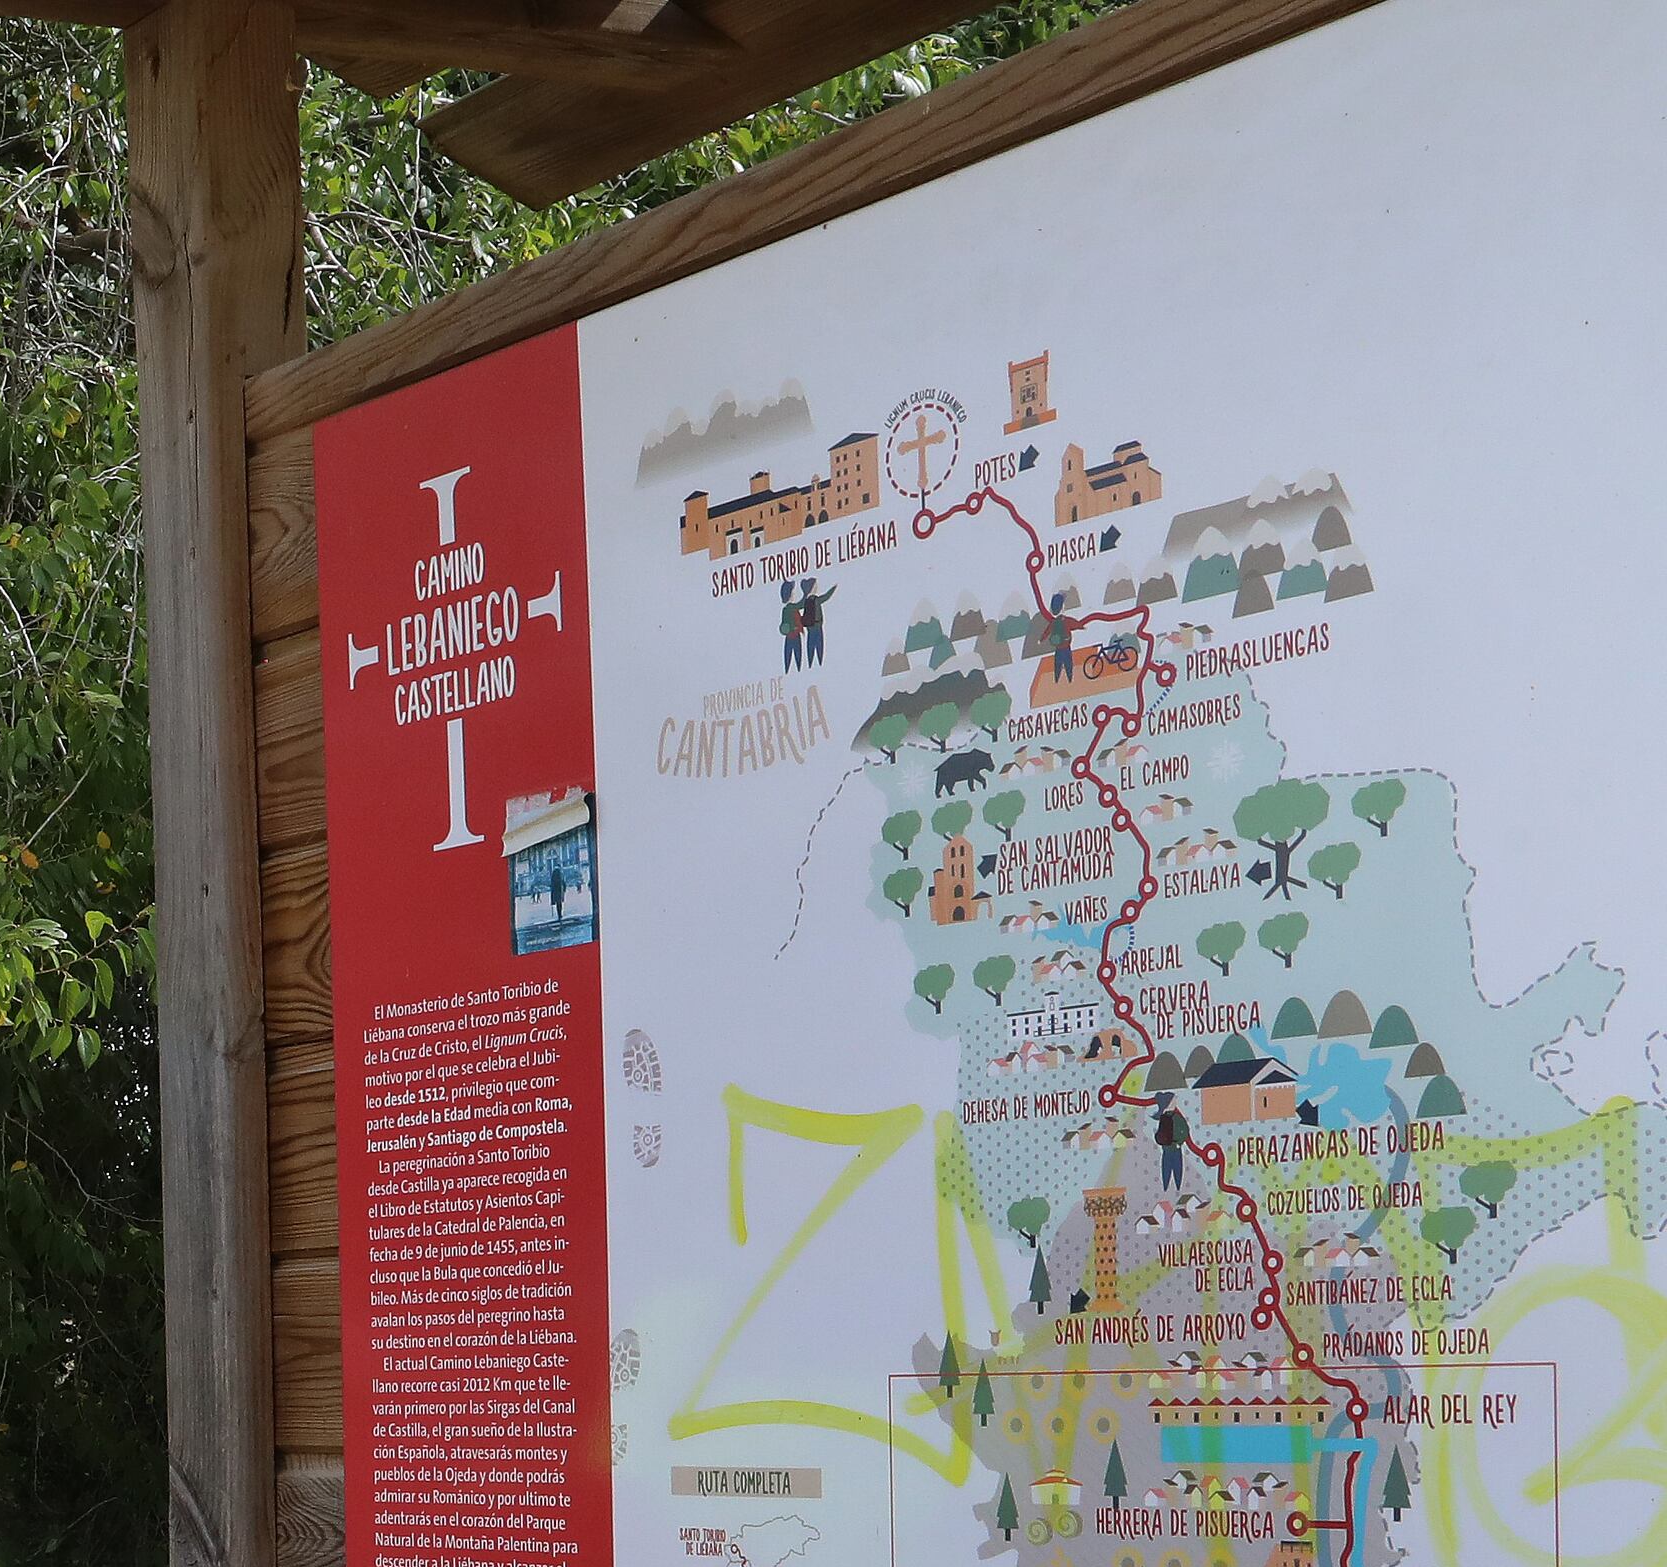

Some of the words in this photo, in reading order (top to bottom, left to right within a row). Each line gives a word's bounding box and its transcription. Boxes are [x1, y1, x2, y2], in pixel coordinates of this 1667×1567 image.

[975, 452, 1016, 488] POTES
[712, 561, 755, 598] SANTO
[761, 549, 809, 586] TORIBIO
[815, 543, 832, 571] DE
[838, 520, 898, 565] LIÉBANA
[1048, 531, 1097, 569] PIASCA
[415, 542, 485, 601] CAMINO
[385, 585, 520, 676] LEBANIEGO
[1187, 624, 1330, 682] PIEDRASLUENGAS
[395, 654, 516, 726] CASTELLANO
[703, 680, 765, 718] PROVINCIA
[770, 675, 785, 702] DE
[657, 685, 831, 778] CANTABRIA
[1008, 703, 1088, 743] CASAVEGAS
[1148, 694, 1242, 737] CAMASOBRES
[1120, 764, 1135, 790] EL
[1143, 754, 1190, 786] CAMPO
[1044, 782, 1084, 812] LORES
[999, 841, 1028, 870] SAN
[1035, 826, 1115, 864] SALVADOR
[998, 869, 1014, 896] DE
[1021, 852, 1114, 891] CANTAMUDA
[1164, 862, 1241, 899] ESTALAYA
[1065, 896, 1108, 926] VAÑES
[1120, 944, 1183, 979] ARBEJAL
[375, 1005, 384, 1020] El
[386, 996, 448, 1019] Monasterio
[451, 992, 465, 1009] de
[468, 990, 500, 1007] Santo
[502, 980, 541, 1000] Toribio
[544, 978, 559, 994] de
[1139, 980, 1210, 1015] CERVERA
[364, 1021, 404, 1043] Liébana
[407, 1016, 455, 1036] conserva
[458, 1012, 467, 1030] el
[470, 1009, 500, 1027] trozo
[502, 1006, 526, 1022] más
[529, 1000, 570, 1024] grande
[1157, 1012, 1175, 1040] DE
[1181, 1001, 1261, 1038] PISUERGA
[366, 1115, 394, 1135] parte
[397, 1110, 428, 1127] desde
[431, 1109, 441, 1124] la
[444, 1103, 471, 1123] Edad
[474, 1099, 509, 1119] media
[512, 1100, 532, 1115] con
[535, 1096, 572, 1113] Roma,
[963, 1099, 1008, 1125] DEHESA
[1013, 1096, 1029, 1121] DE
[1034, 1090, 1090, 1119] MONTEJO
[366, 1133, 417, 1153] Jerusalén
[419, 1136, 425, 1151] y
[427, 1125, 476, 1148] Santiago
[479, 1125, 492, 1142] de
[495, 1118, 568, 1140] Compostela.
[1237, 1127, 1349, 1169] PERAZANCAS
[1358, 1126, 1379, 1156] DE
[1386, 1121, 1445, 1154] OJEDA
[1267, 1185, 1341, 1216] COZUELOS
[1347, 1184, 1366, 1211] DE
[1373, 1181, 1423, 1211] OJEDA
[1158, 1238, 1254, 1268] VILLAESCUSA
[1195, 1268, 1213, 1293] DE
[1218, 1266, 1254, 1292] ECLA
[1385, 1276, 1405, 1302] DE
[1412, 1274, 1452, 1302] ECLA
[1055, 1316, 1087, 1345] SAN
[1091, 1308, 1151, 1349] ANDRÉS
[1157, 1315, 1175, 1343] DE
[1182, 1312, 1247, 1346] ARROYO
[1323, 1324, 1404, 1363] PRÁDANOS
[1411, 1329, 1430, 1356] DE
[1437, 1327, 1490, 1357] OJEDA
[1383, 1394, 1436, 1429] ALAR
[1441, 1394, 1473, 1424] DEL
[1482, 1393, 1517, 1430] REY
[697, 1470, 728, 1497] RUTA
[733, 1471, 791, 1495] COMPLETA
[1096, 1507, 1164, 1541] HERRERA
[1169, 1509, 1189, 1538] DE
[1195, 1509, 1274, 1541] PISUERGA
